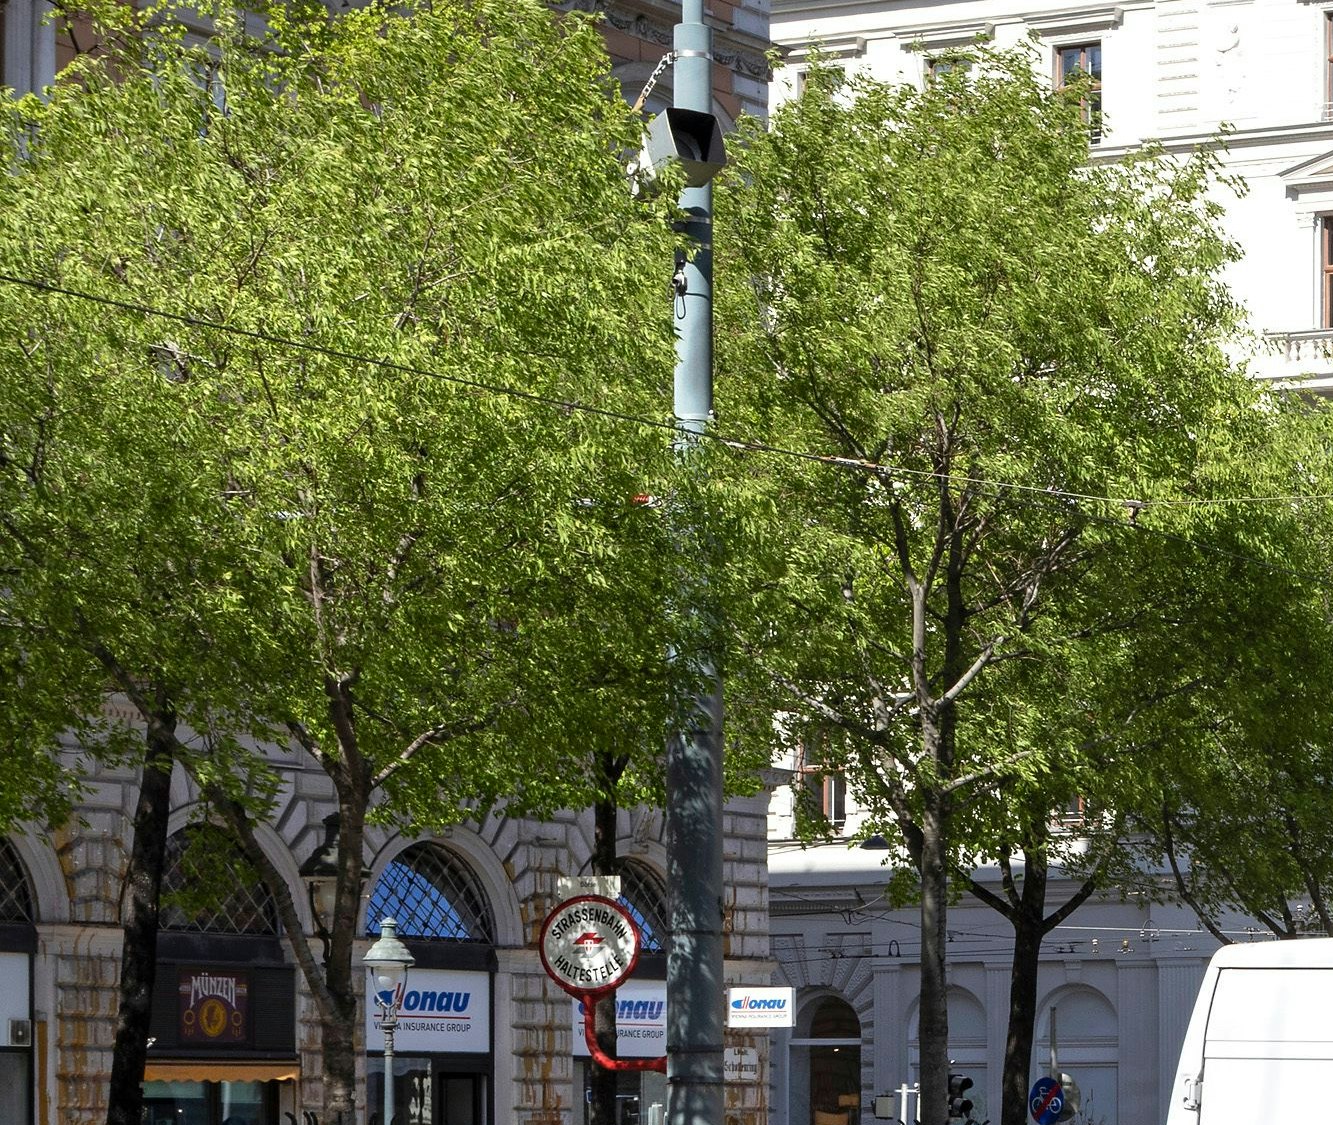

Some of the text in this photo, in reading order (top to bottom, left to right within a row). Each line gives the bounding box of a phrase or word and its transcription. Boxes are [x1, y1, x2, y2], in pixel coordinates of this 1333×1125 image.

[551, 908, 627, 940] STRASSENBAHN
[554, 955, 624, 982] HALTESTELLE
[190, 972, 236, 1010] MÜNZEN
[404, 1023, 444, 1032] INSURANCE
[447, 1024, 471, 1032] GROUP
[642, 1029, 664, 1038] GROUP
